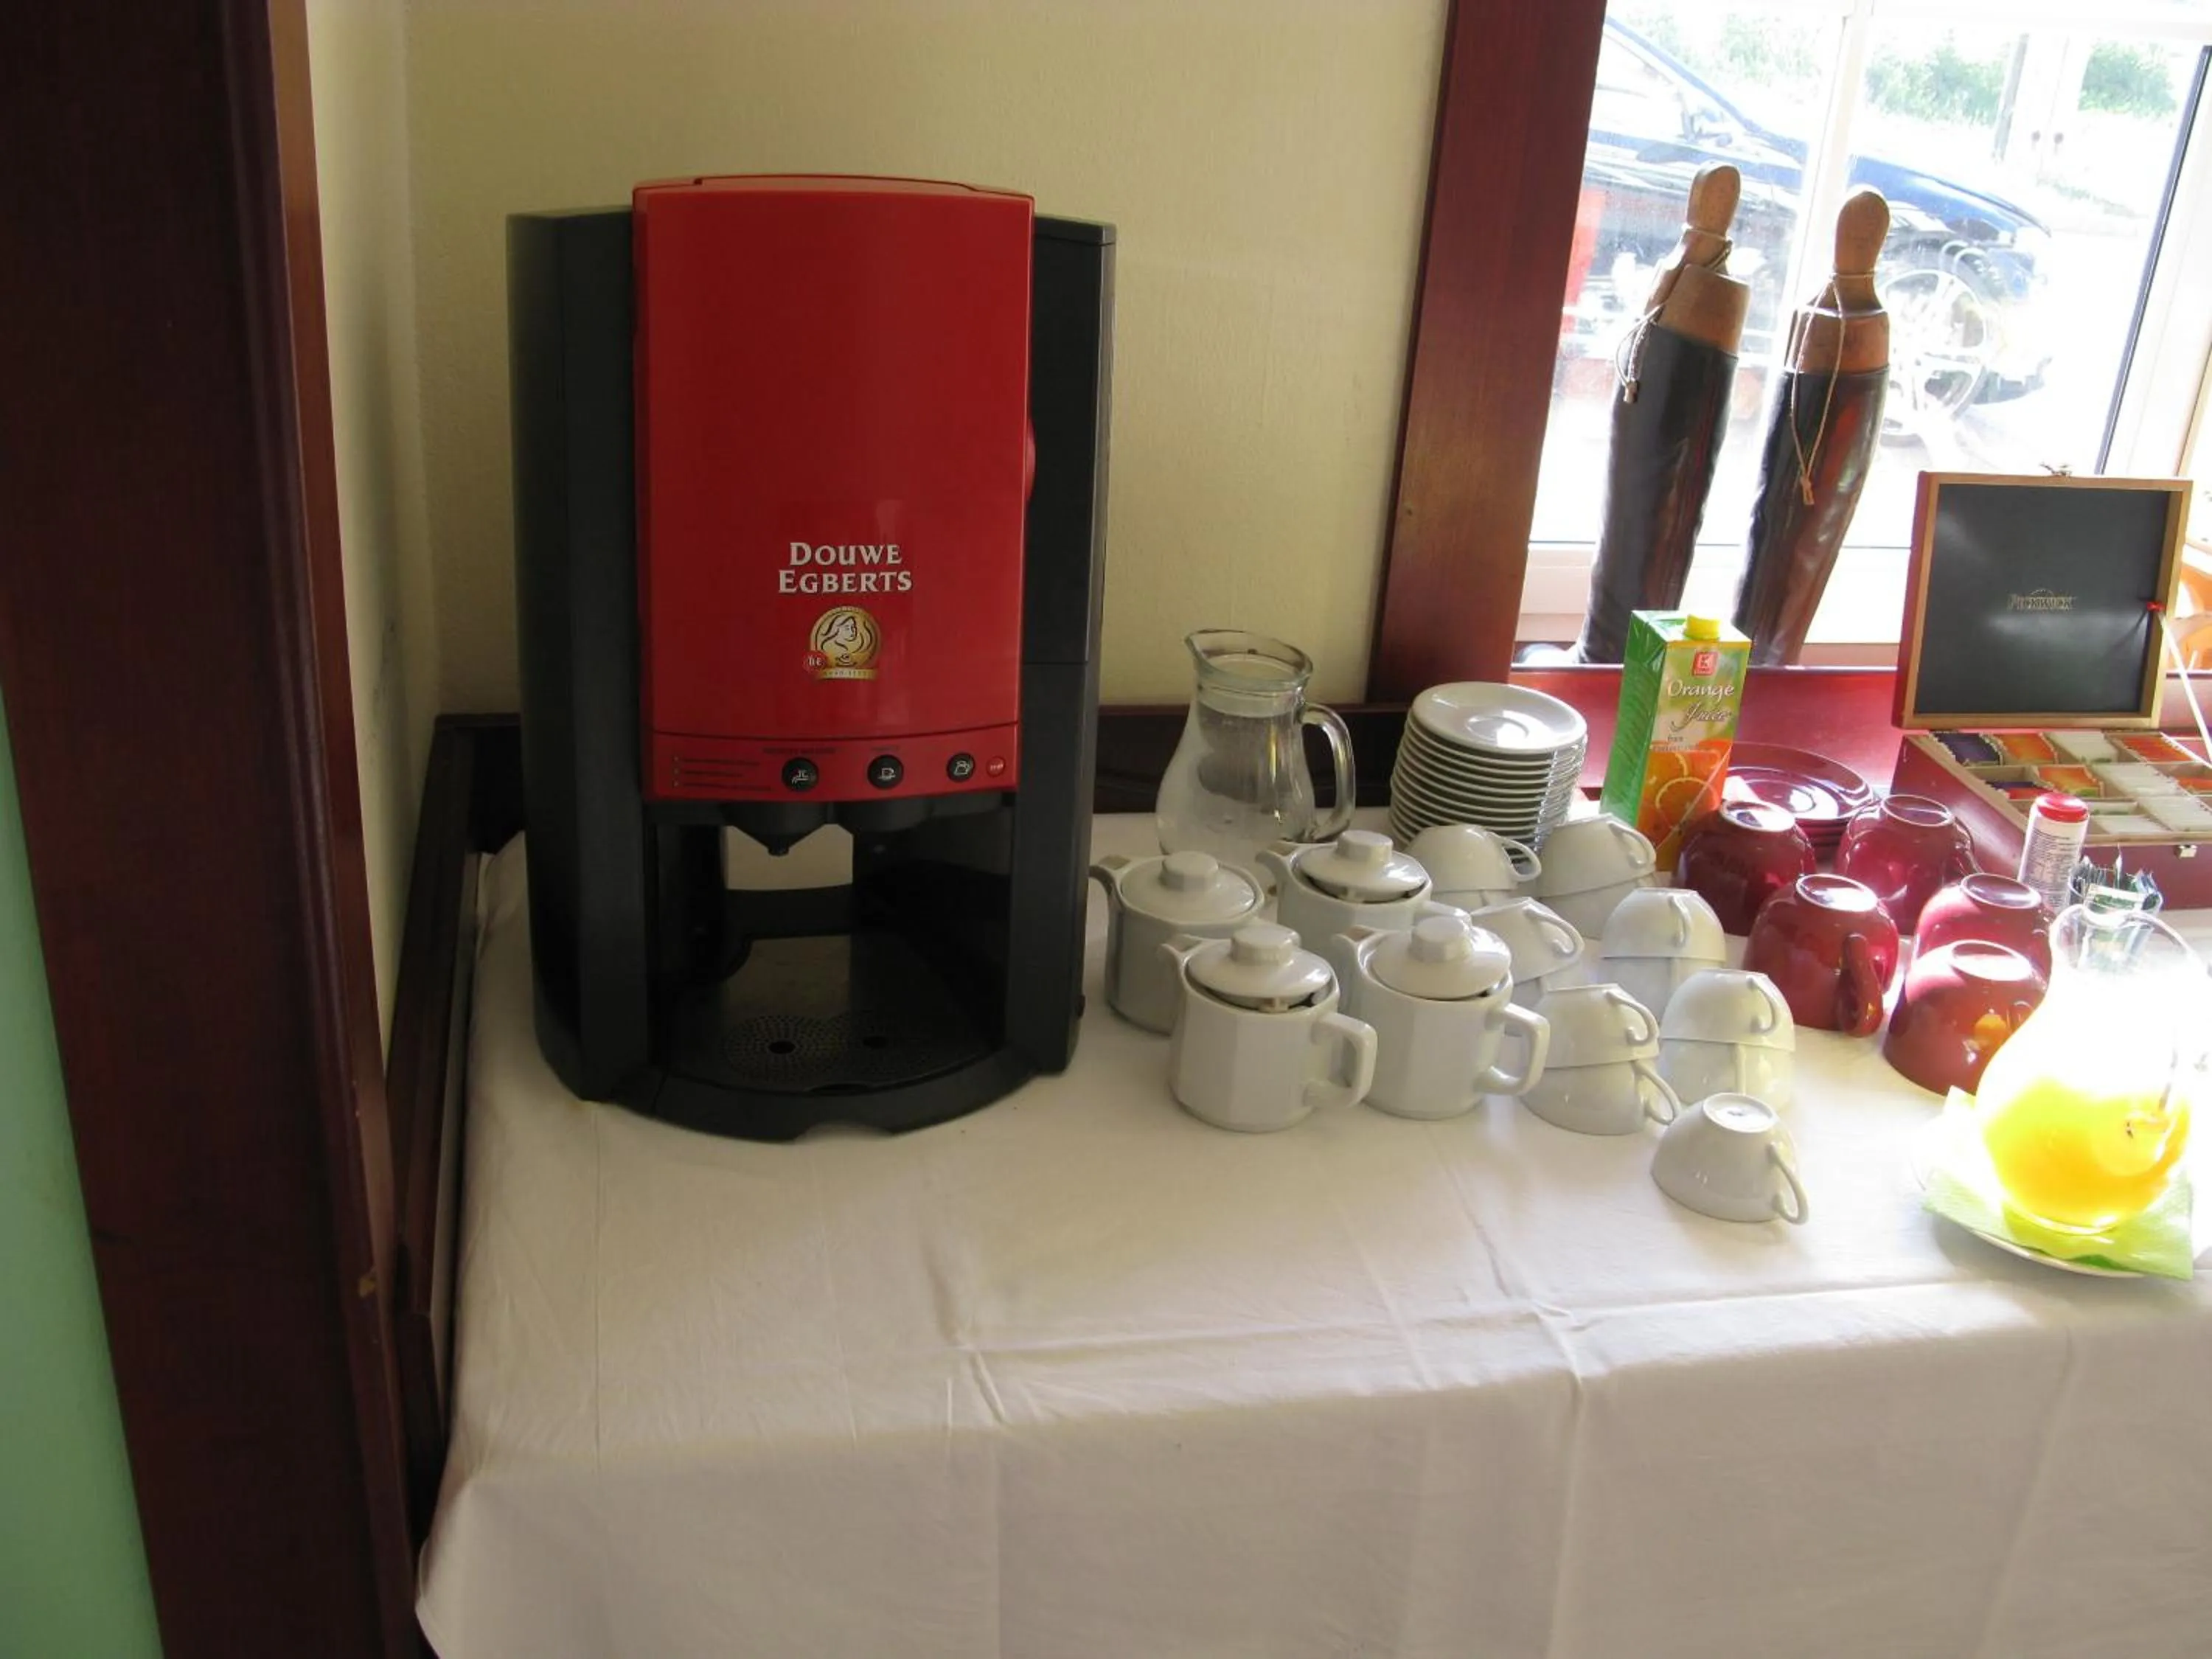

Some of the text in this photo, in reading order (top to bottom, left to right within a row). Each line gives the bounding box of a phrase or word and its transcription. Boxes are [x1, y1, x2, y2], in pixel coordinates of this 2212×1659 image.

[790, 542, 902, 566] DOUWE
[778, 569, 913, 594] EGBERTS
[1667, 678, 1735, 708] Orange
[1669, 701, 1732, 733] Juice
